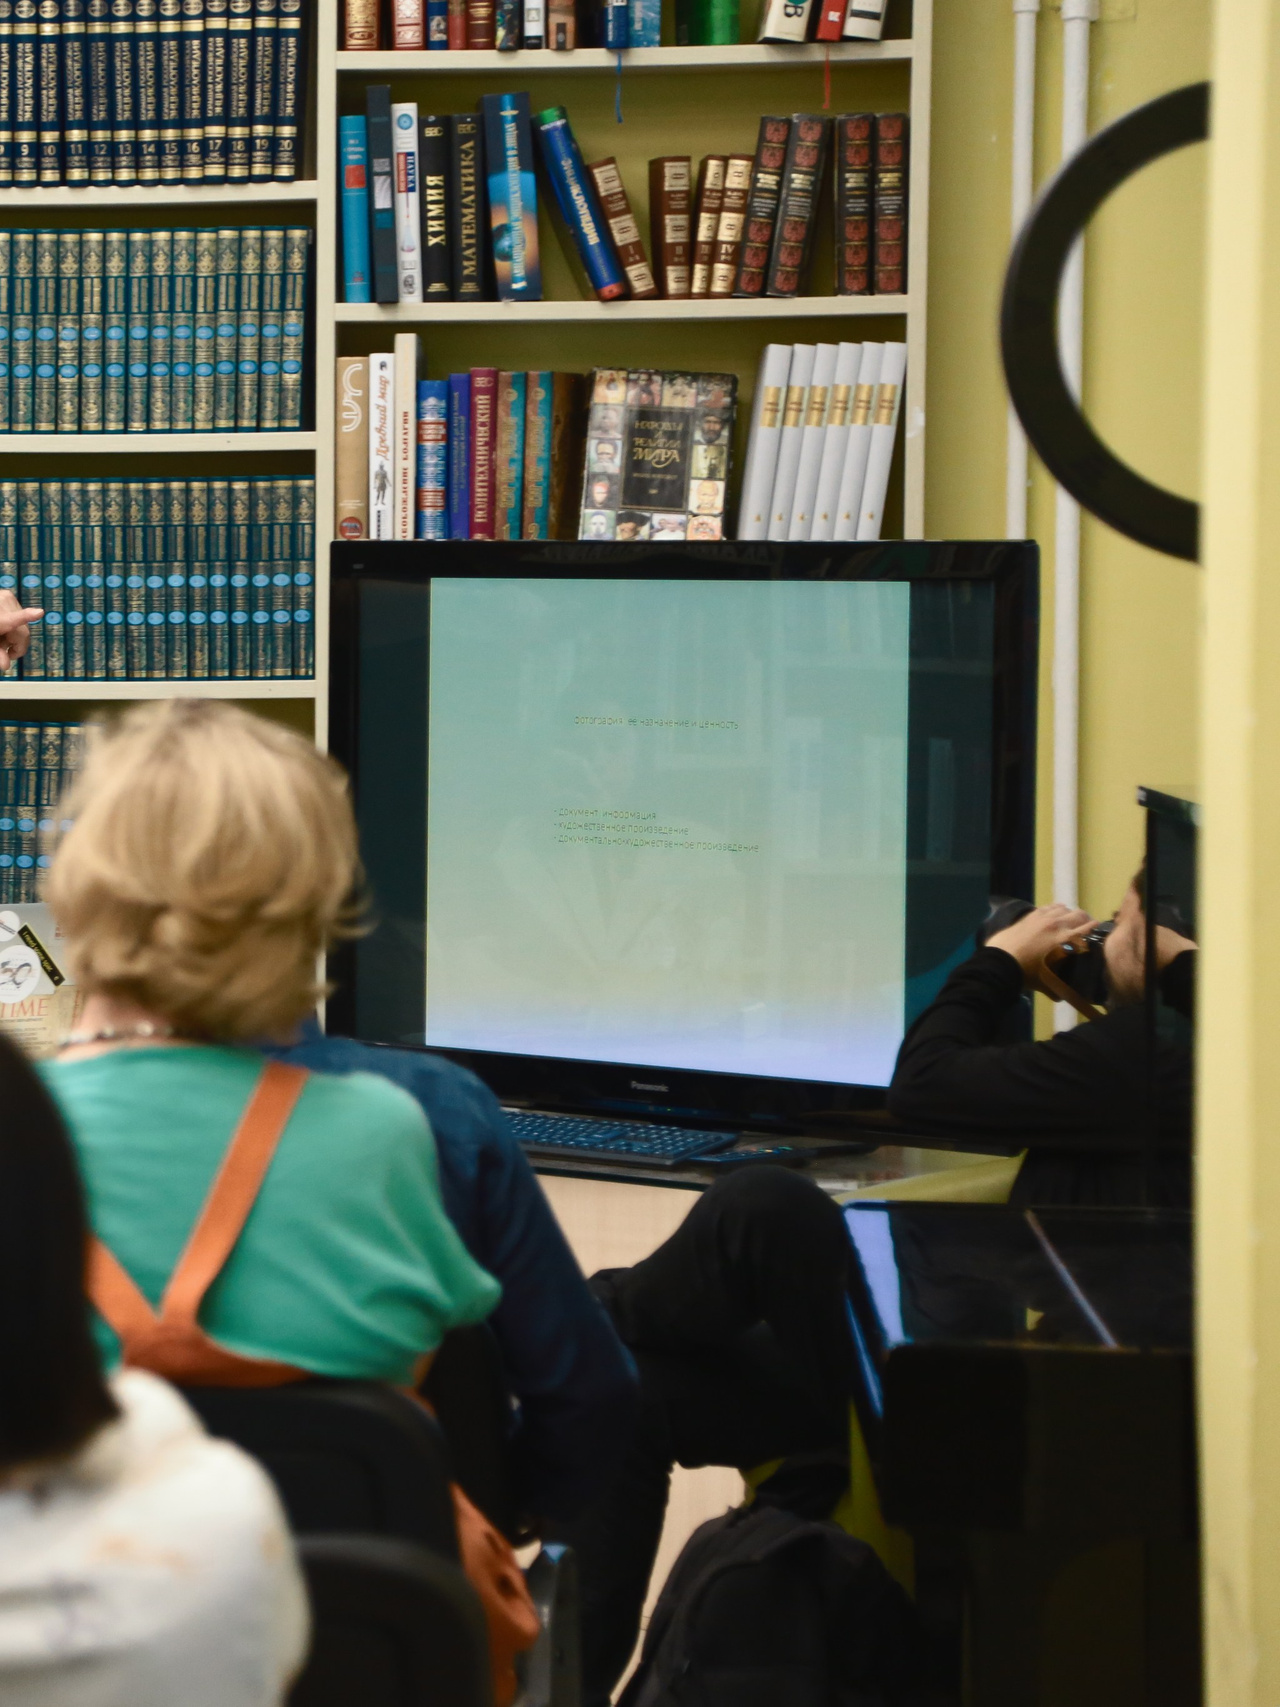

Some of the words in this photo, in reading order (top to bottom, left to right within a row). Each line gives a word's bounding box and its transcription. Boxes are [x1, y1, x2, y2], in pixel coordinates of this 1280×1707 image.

[21, 145, 29, 155] 9
[44, 144, 56, 155] 10
[70, 144, 83, 154] 11
[94, 144, 107, 155] 12
[119, 144, 131, 155] 13
[142, 143, 156, 153] 14
[165, 142, 178, 153] 15
[187, 142, 200, 153] 16
[209, 140, 222, 150] 17
[231, 141, 245, 151] 18
[255, 140, 268, 150] 19
[279, 140, 293, 150] 20
[426, 175, 446, 247] ХИМИЯ
[460, 140, 477, 276] МАТЕМАТИКА
[380, 375, 390, 401] мир
[634, 420, 683, 431] НАРОДЫ
[376, 404, 390, 461] Древний
[474, 395, 491, 523] ПОЛИТЕХНИЧЕСКИЙ
[632, 448, 680, 468] МИРА
[639, 719, 689, 728] назначение
[699, 721, 739, 730] ценность
[602, 810, 656, 820] информация
[558, 822, 626, 832] художественное
[628, 824, 689, 836] произведение
[558, 834, 694, 850] документально-художественное
[697, 841, 759, 853] произведение
[0, 998, 48, 1018] TIME
[630, 1080, 670, 1092] Panasonic
